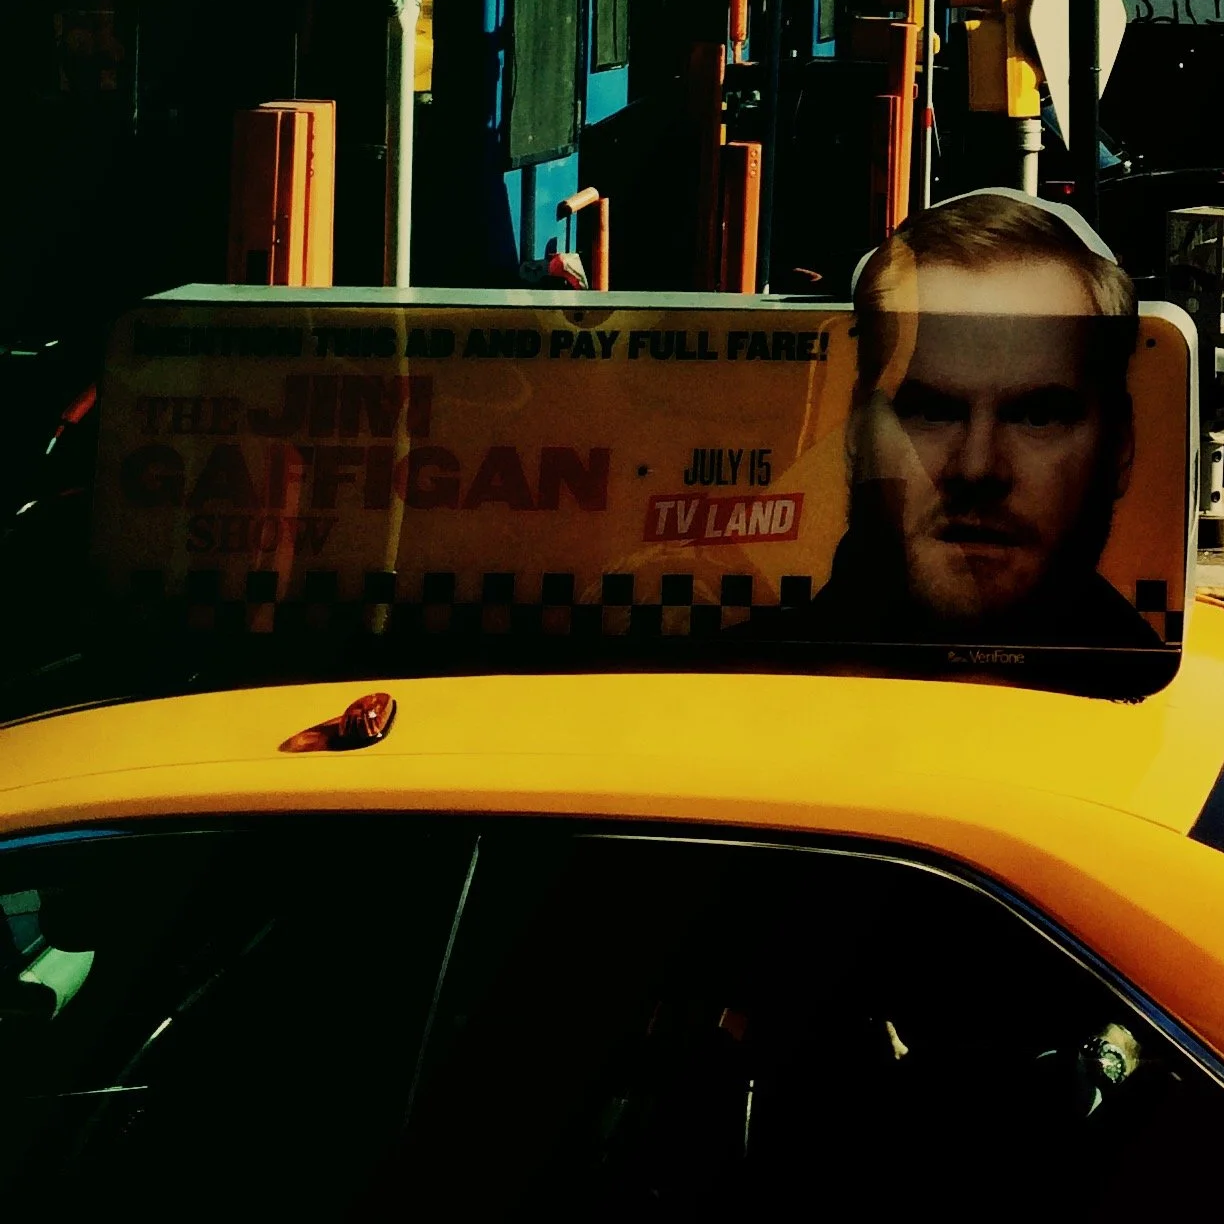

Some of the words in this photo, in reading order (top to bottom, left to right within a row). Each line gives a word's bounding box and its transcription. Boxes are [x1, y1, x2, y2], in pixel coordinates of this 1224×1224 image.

[406, 328, 455, 358] AD
[463, 328, 541, 358] AND
[550, 330, 619, 359] PAY
[628, 330, 718, 360] FULL
[728, 331, 829, 361] FARE!
[137, 396, 240, 436] THE
[248, 375, 433, 438] JIM
[119, 444, 610, 512] GAFFIGAN
[684, 447, 744, 486] JULY
[750, 448, 772, 487] 15
[187, 516, 338, 555] SHOW
[655, 498, 700, 536] TV
[703, 499, 796, 539] LAND
